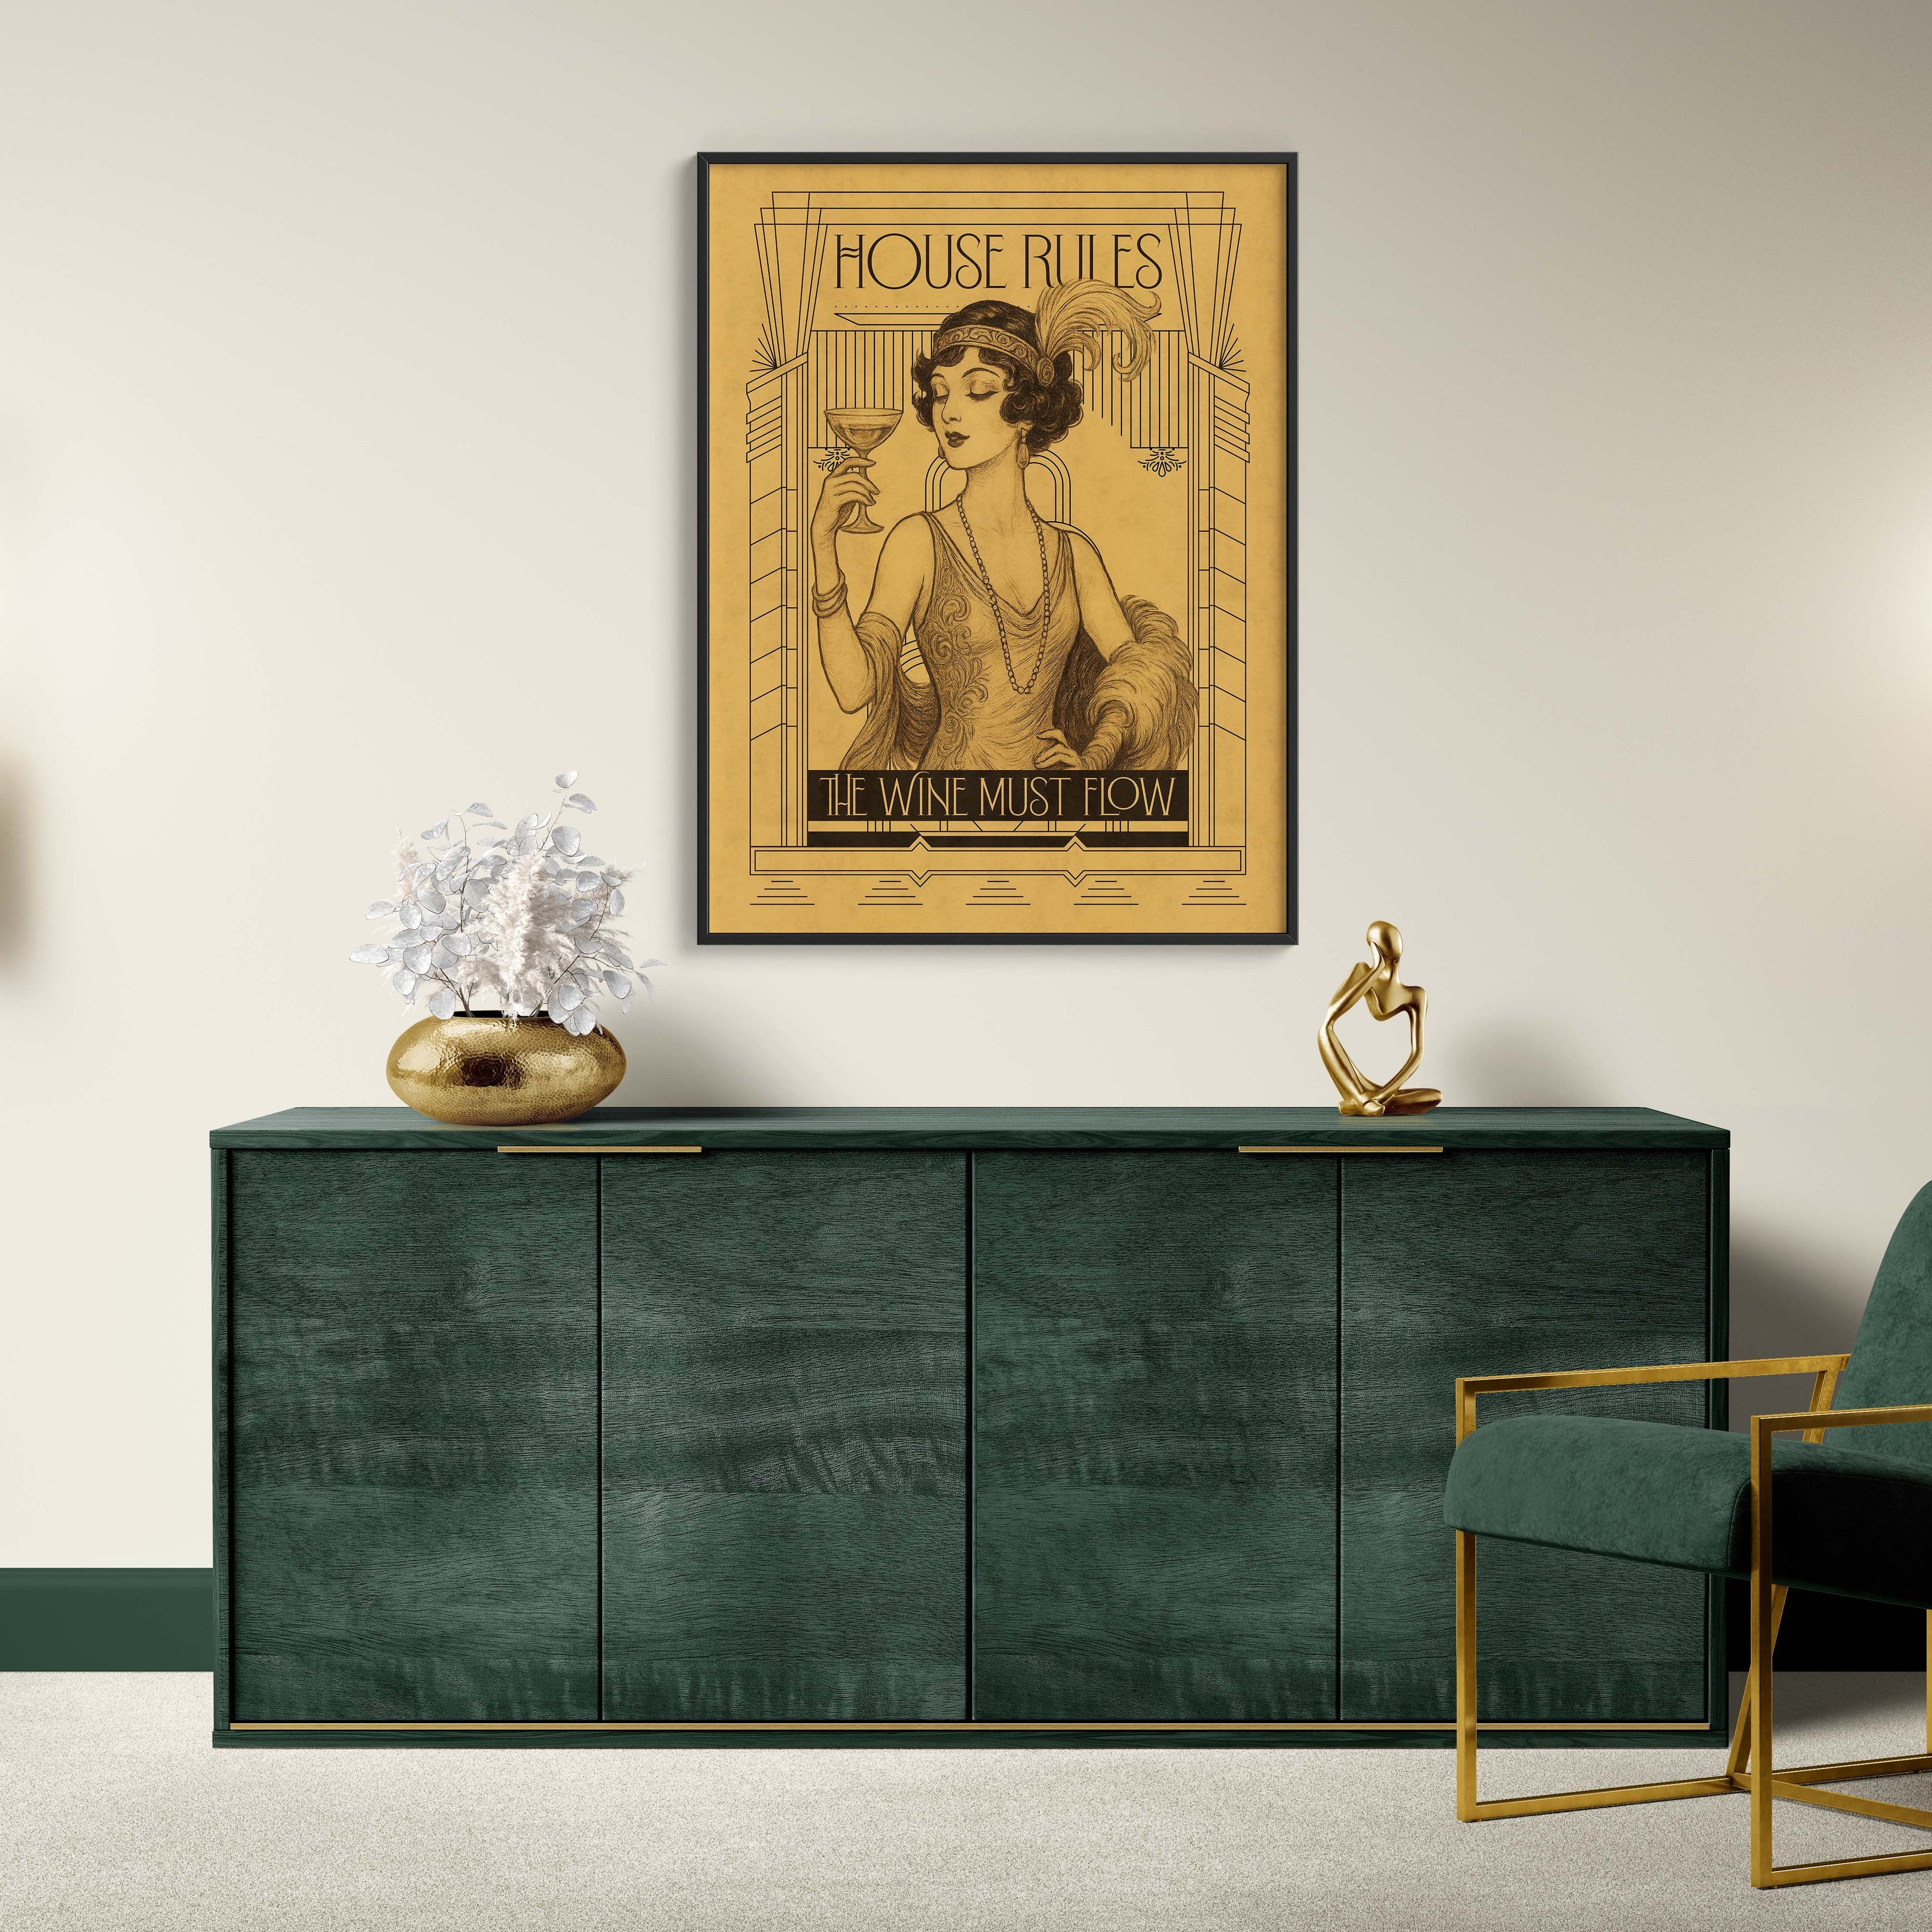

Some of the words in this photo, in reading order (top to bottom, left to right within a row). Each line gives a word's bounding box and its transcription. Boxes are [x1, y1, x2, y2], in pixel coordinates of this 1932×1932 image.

[834, 233, 1007, 290] HOUSE
[820, 773, 868, 816] THE
[879, 771, 969, 816] WINE
[979, 776, 1072, 817] MUST
[1083, 776, 1177, 816] FLOW
